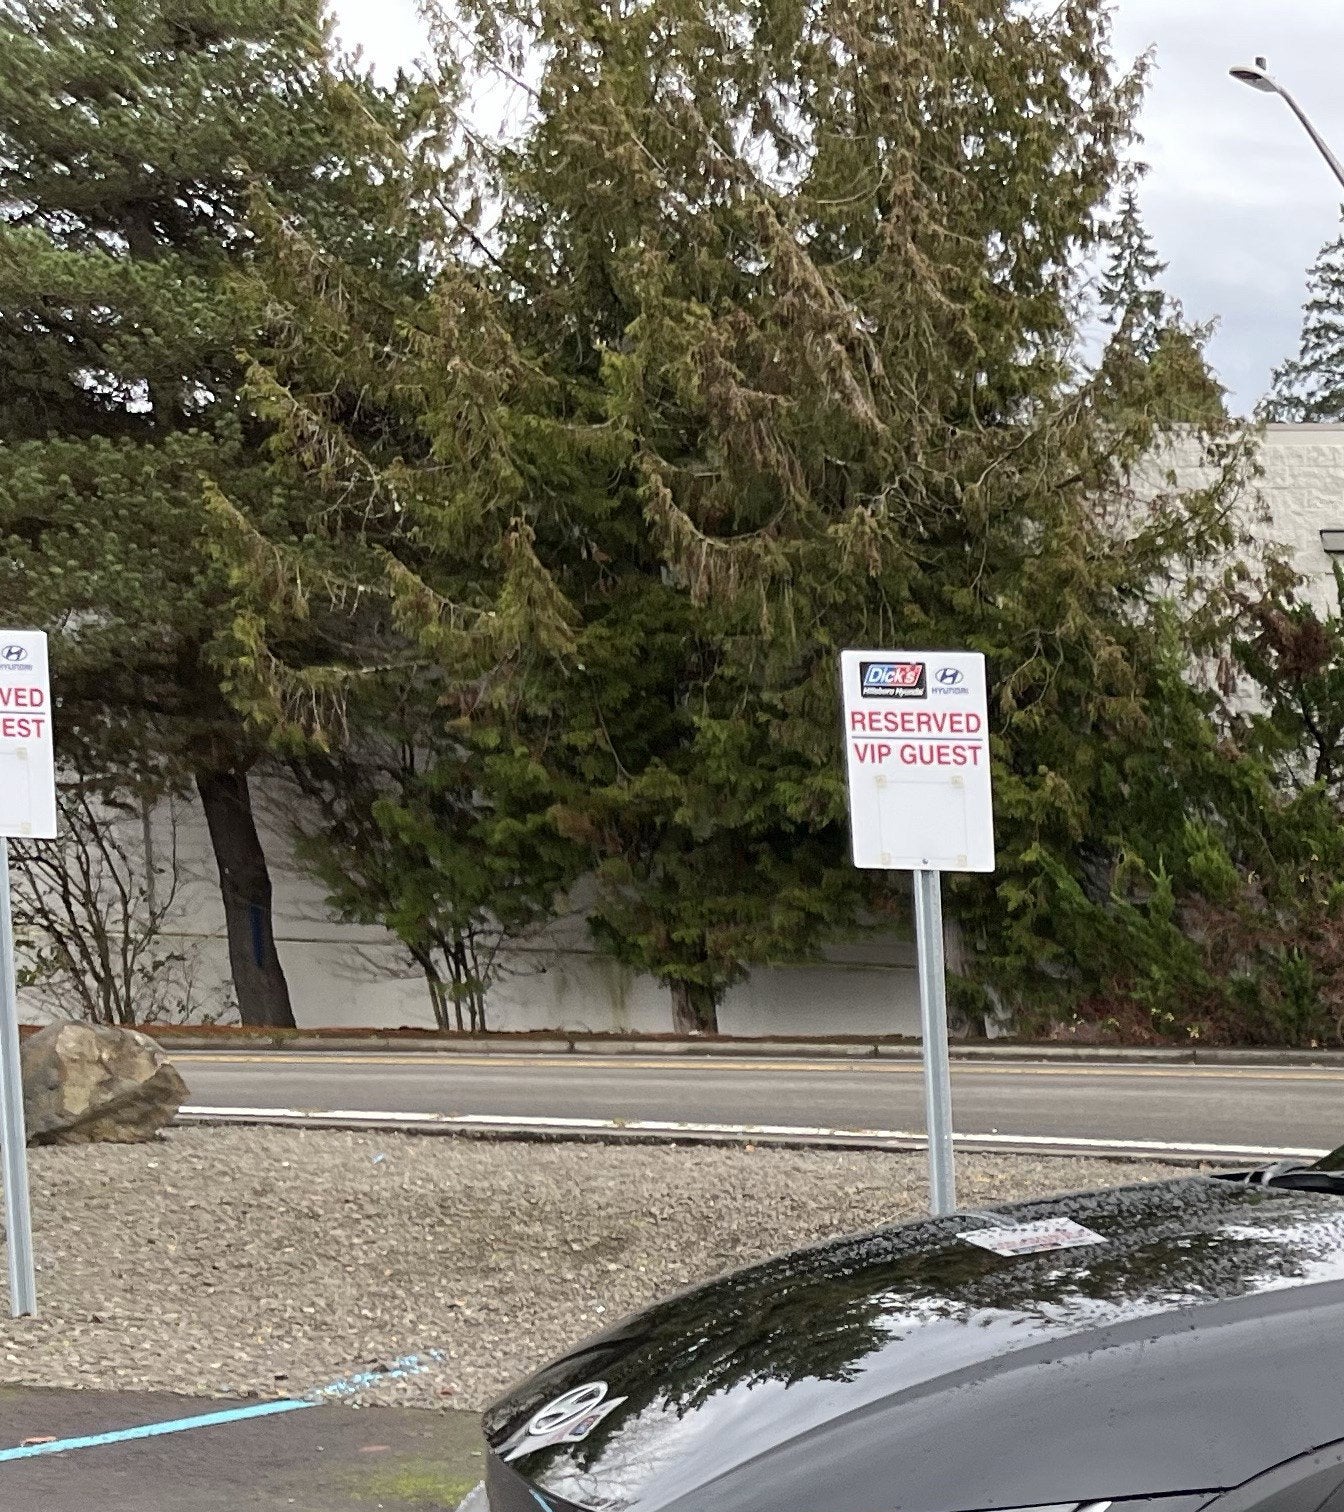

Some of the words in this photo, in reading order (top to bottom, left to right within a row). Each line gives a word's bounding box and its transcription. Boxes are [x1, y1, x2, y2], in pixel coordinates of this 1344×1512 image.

[850, 711, 981, 733] RESERVED
[854, 744, 892, 764] VIP
[900, 745, 982, 765] GUEST
